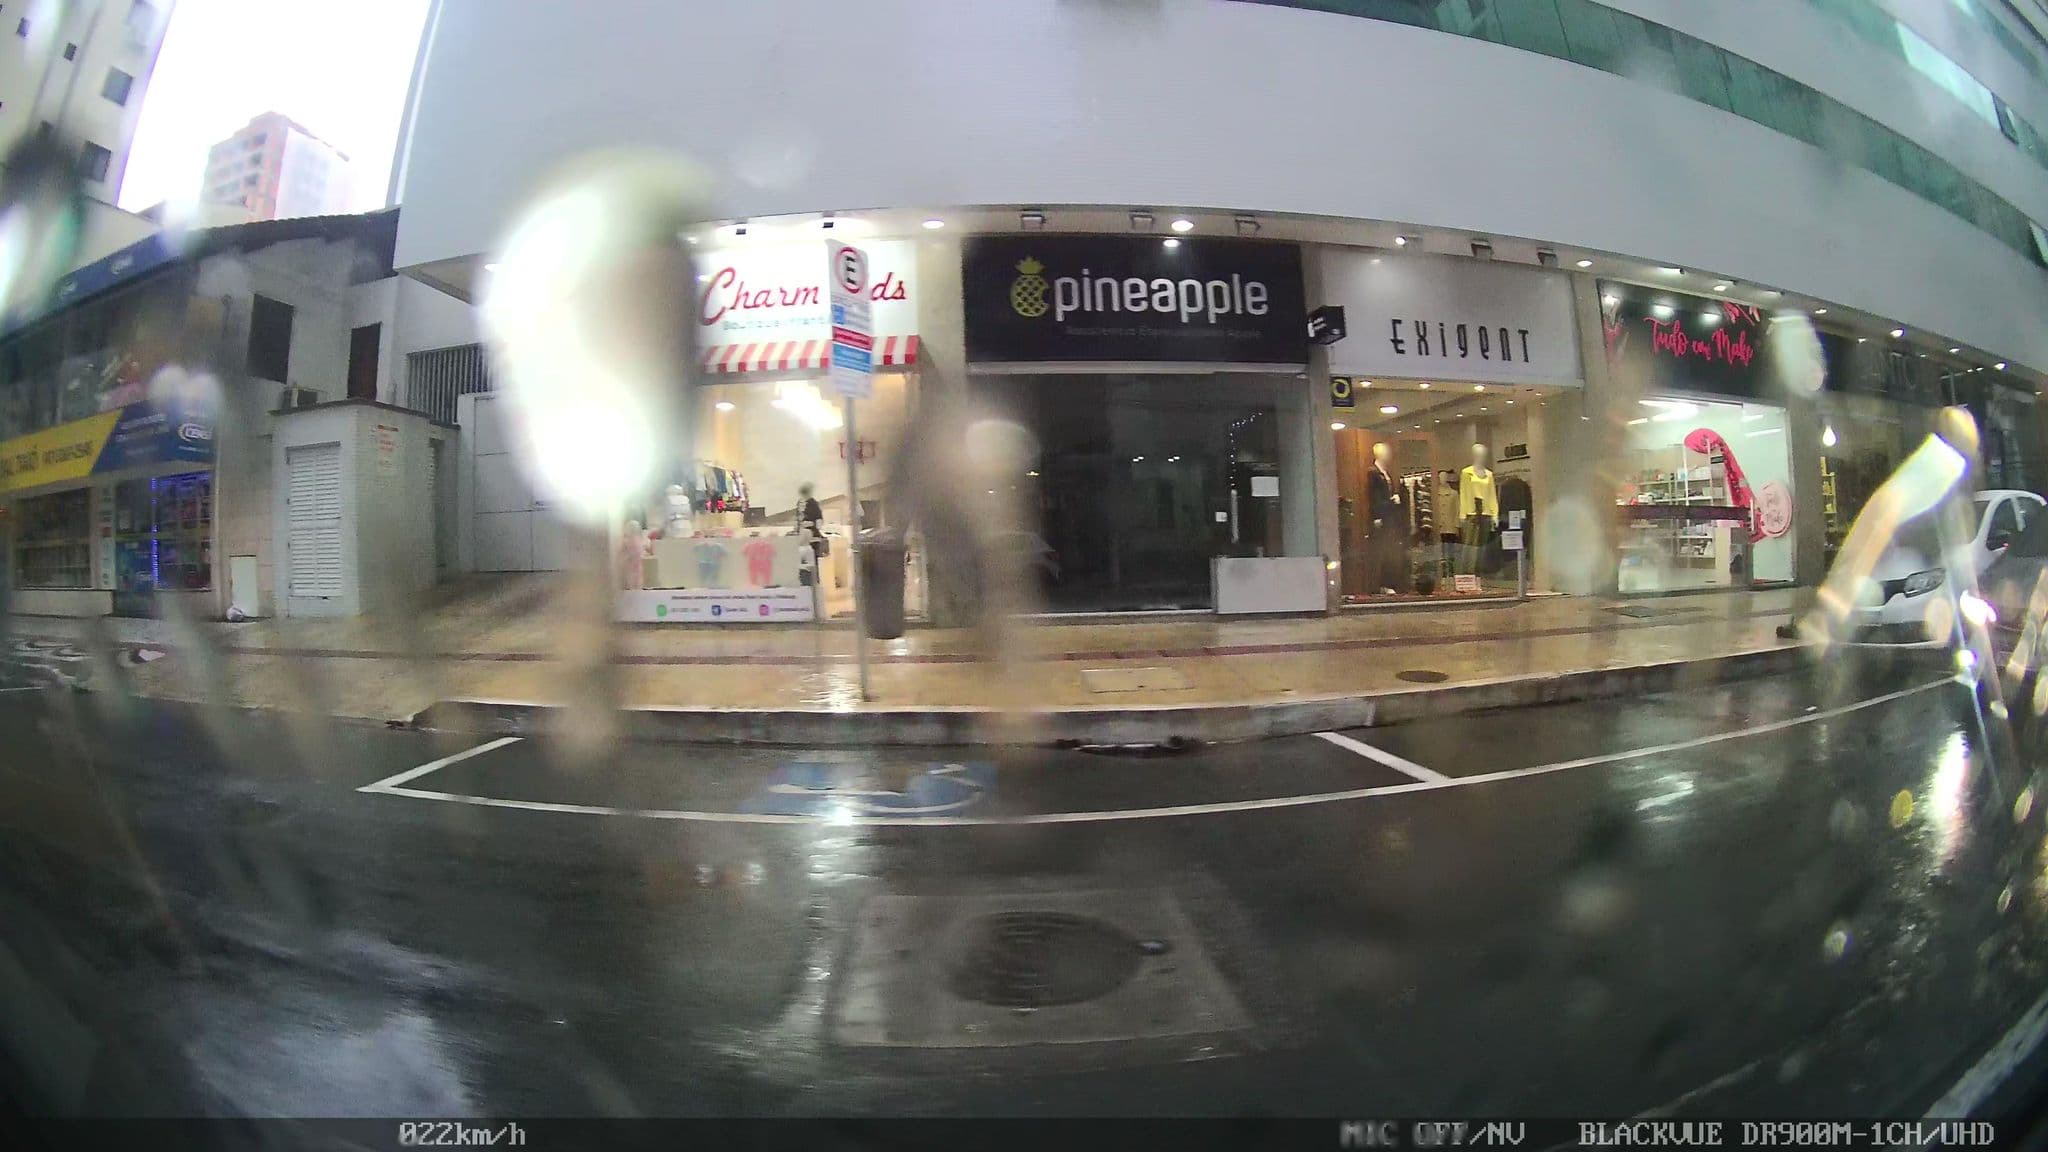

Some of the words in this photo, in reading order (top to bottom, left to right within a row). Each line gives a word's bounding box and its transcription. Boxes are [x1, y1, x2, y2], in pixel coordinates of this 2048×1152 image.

[701, 267, 819, 326] Charm
[843, 255, 856, 286] E
[1054, 268, 1269, 324] pineapple
